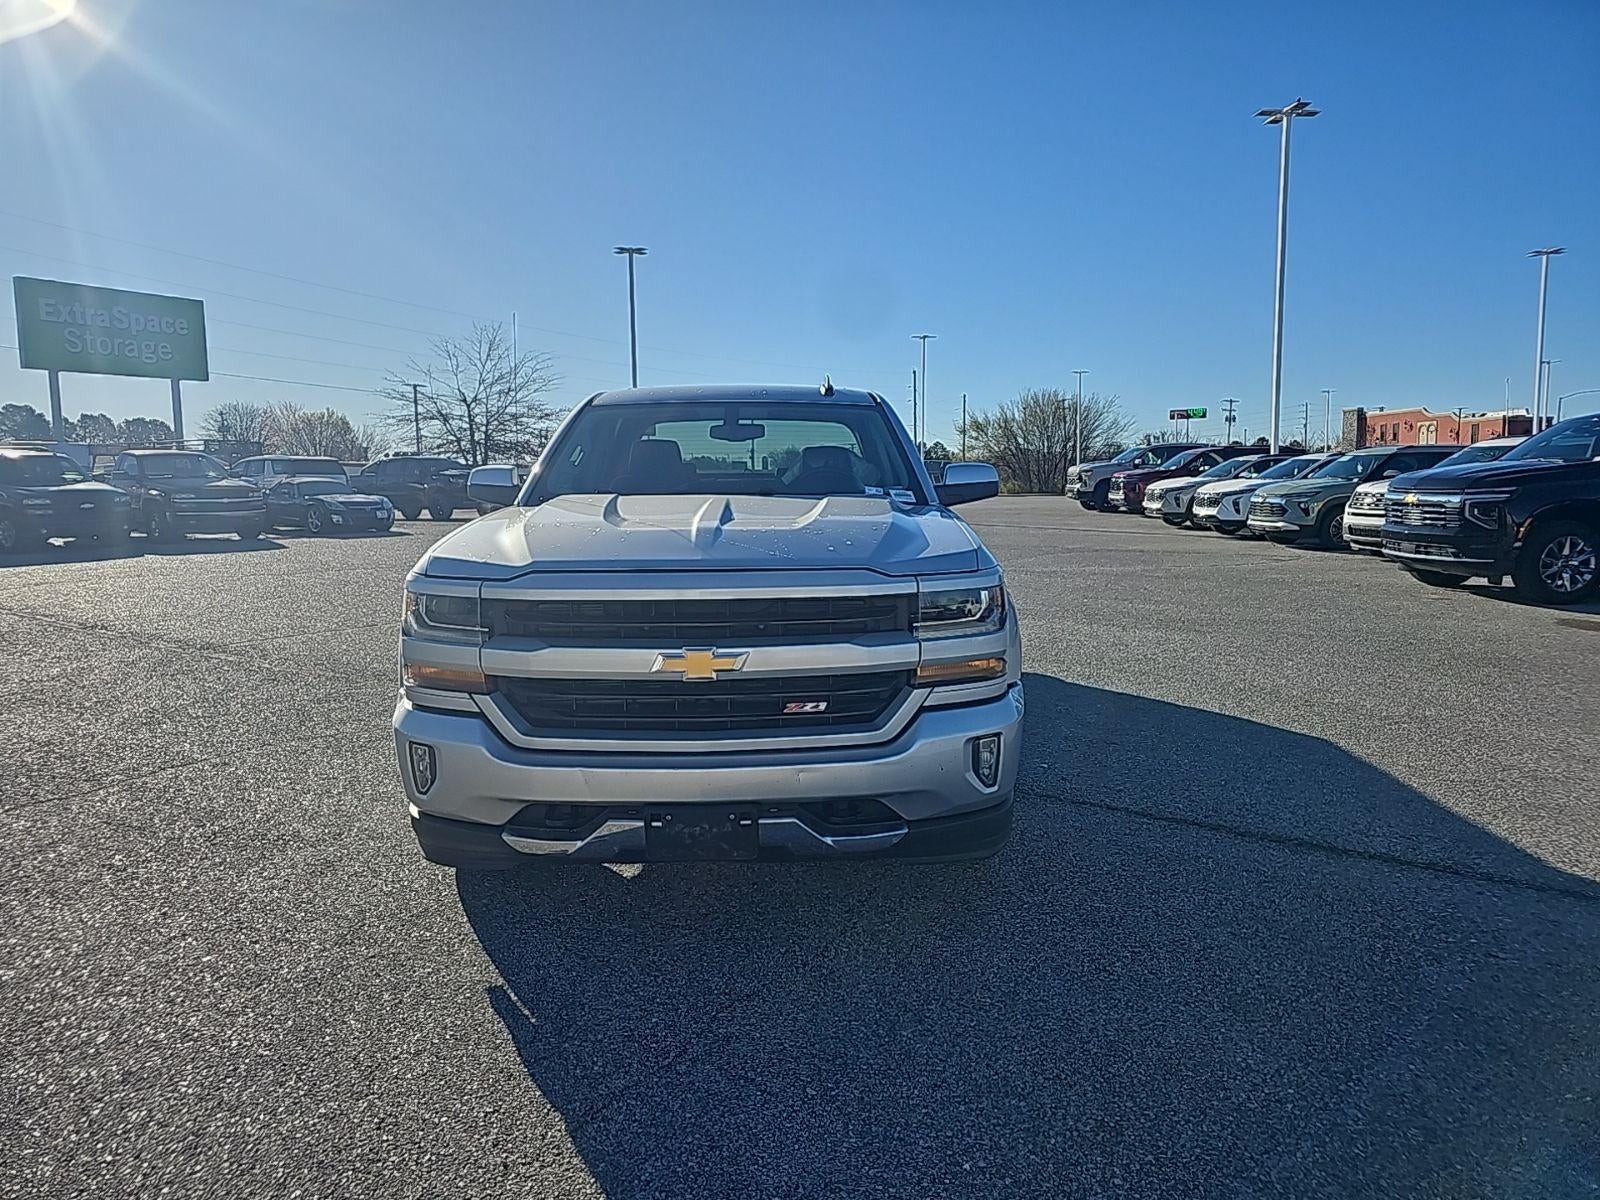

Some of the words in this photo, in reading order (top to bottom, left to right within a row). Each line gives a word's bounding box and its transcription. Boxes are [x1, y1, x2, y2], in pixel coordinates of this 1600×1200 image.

[38, 297, 189, 335] ExtraSpace
[64, 328, 173, 364] Storage
[783, 701, 828, 713] Z71
